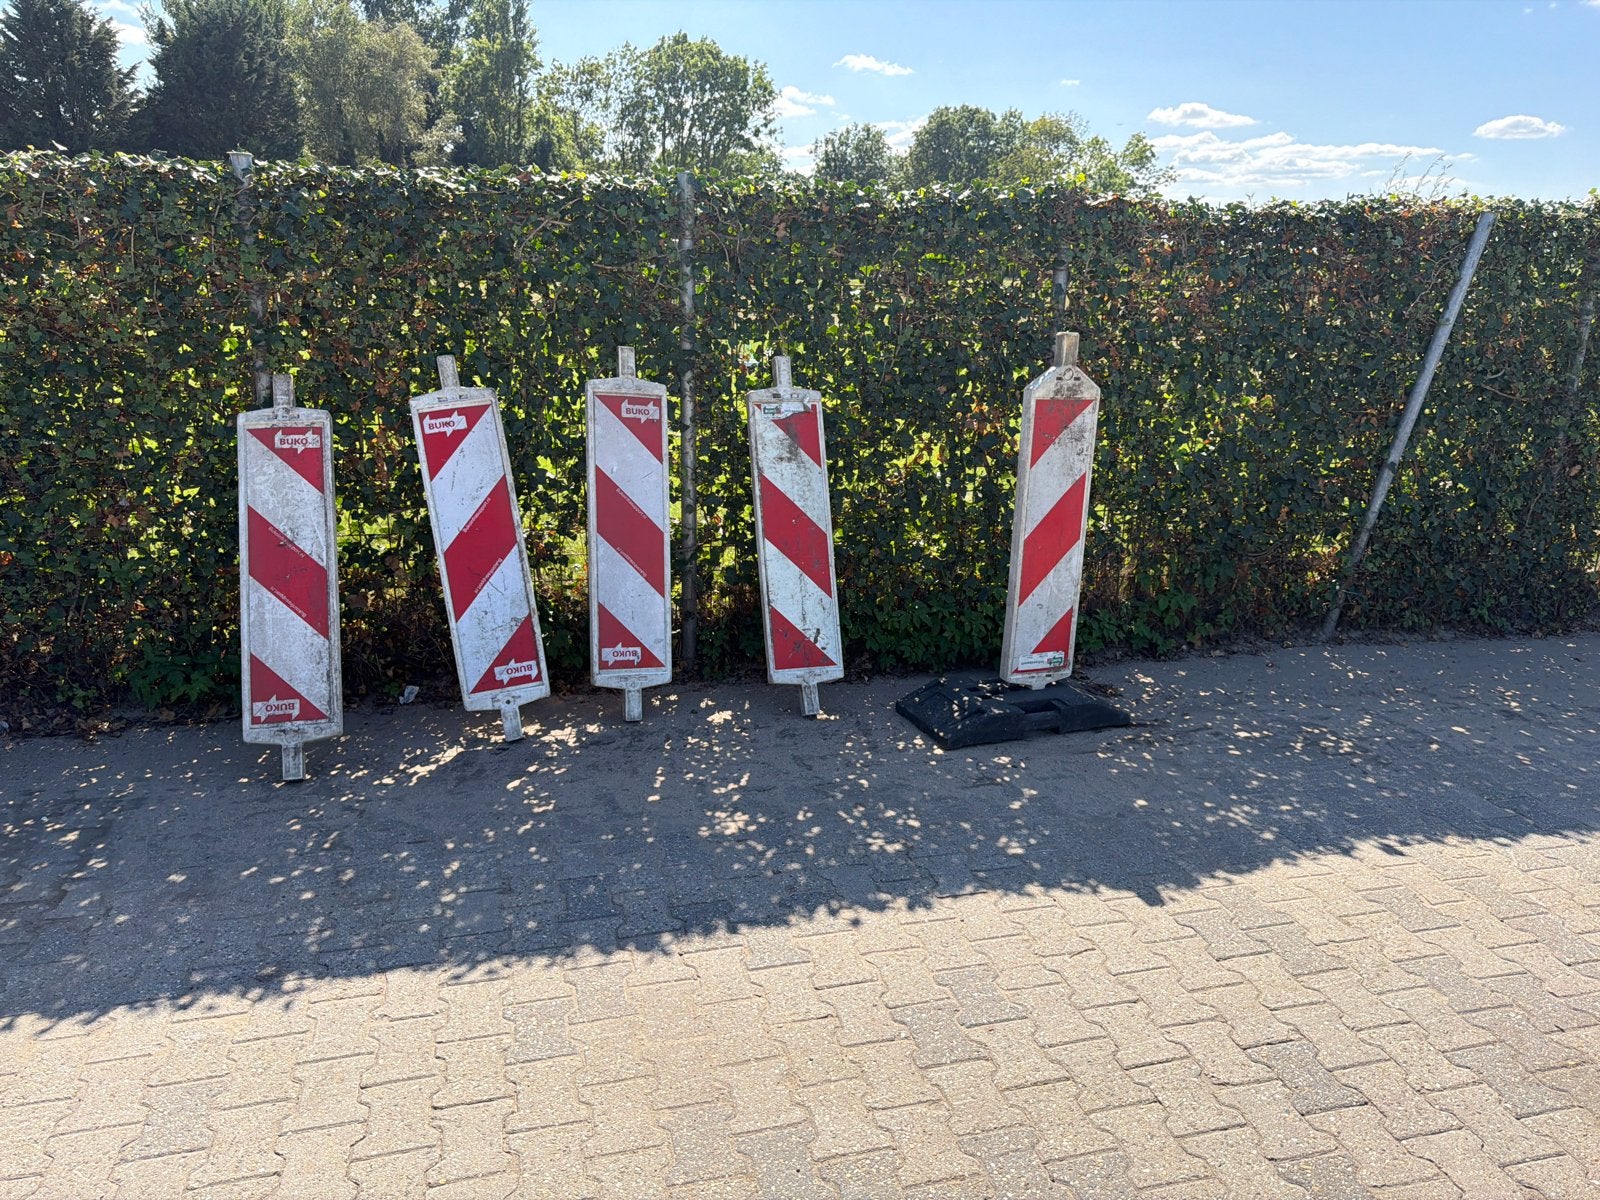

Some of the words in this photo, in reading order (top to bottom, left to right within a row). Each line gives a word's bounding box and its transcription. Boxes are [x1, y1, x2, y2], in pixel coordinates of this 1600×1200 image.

[624, 407, 650, 416] BUKO
[428, 420, 456, 430] BUKO
[279, 437, 308, 446] BUKO
[612, 650, 638, 658] BUKO
[506, 664, 533, 675] BUKO
[265, 702, 295, 712] BUKO
